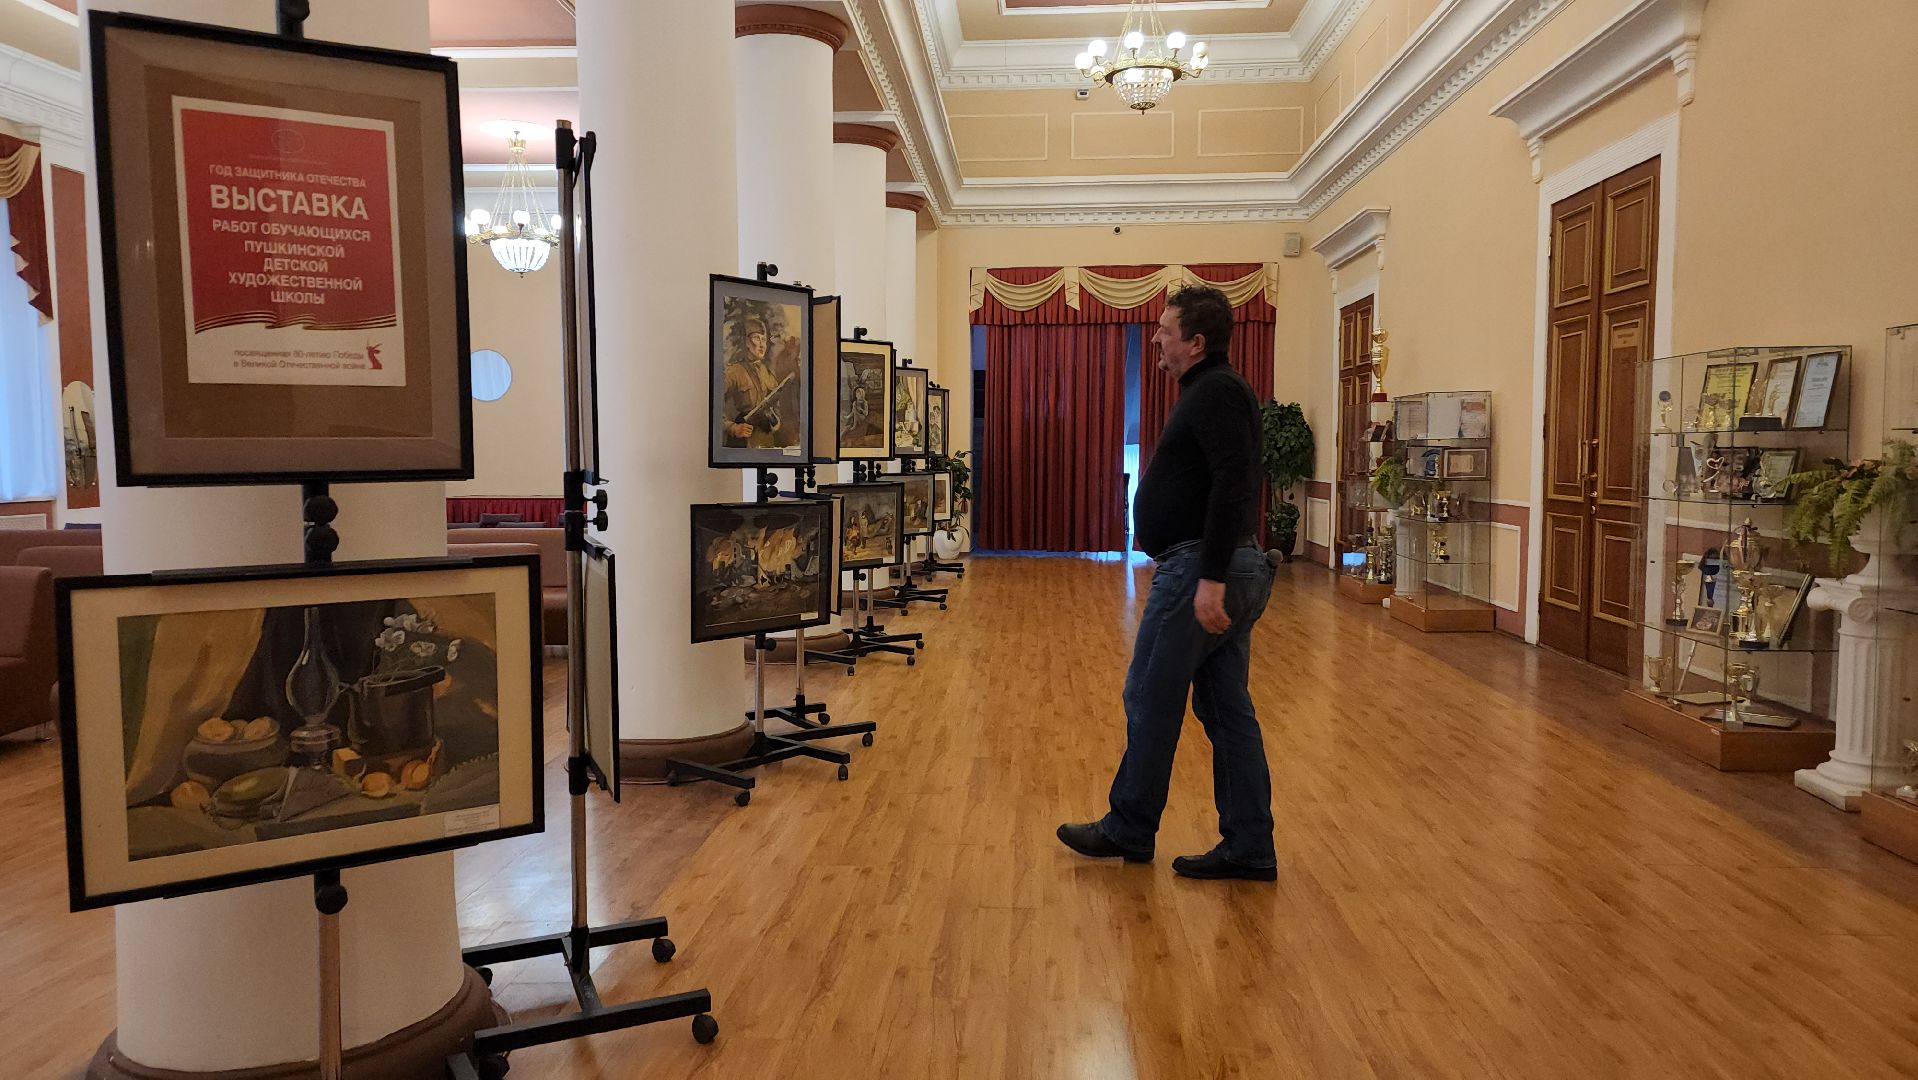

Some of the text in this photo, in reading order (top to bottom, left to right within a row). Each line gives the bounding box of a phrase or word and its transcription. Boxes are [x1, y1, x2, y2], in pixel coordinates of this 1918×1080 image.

[209, 164, 367, 188] ГОД ЗАЩИТНИКА ОТЕЧЕСТВА
[210, 184, 370, 220] ВЫСТАВКА
[212, 219, 371, 242] РАБОТ ОБУЧАЮЩИХСЯ
[244, 240, 345, 258] ПУШКИНСКОЙ
[263, 257, 329, 273] ДЕТСКОЙ
[228, 271, 363, 290] ХУДОЖЕСТВЕННОЙ
[270, 290, 326, 304] ШКОЛЫ
[241, 359, 277, 368] Великой
[279, 360, 340, 369] Отечественной
[332, 350, 364, 360] Победы
